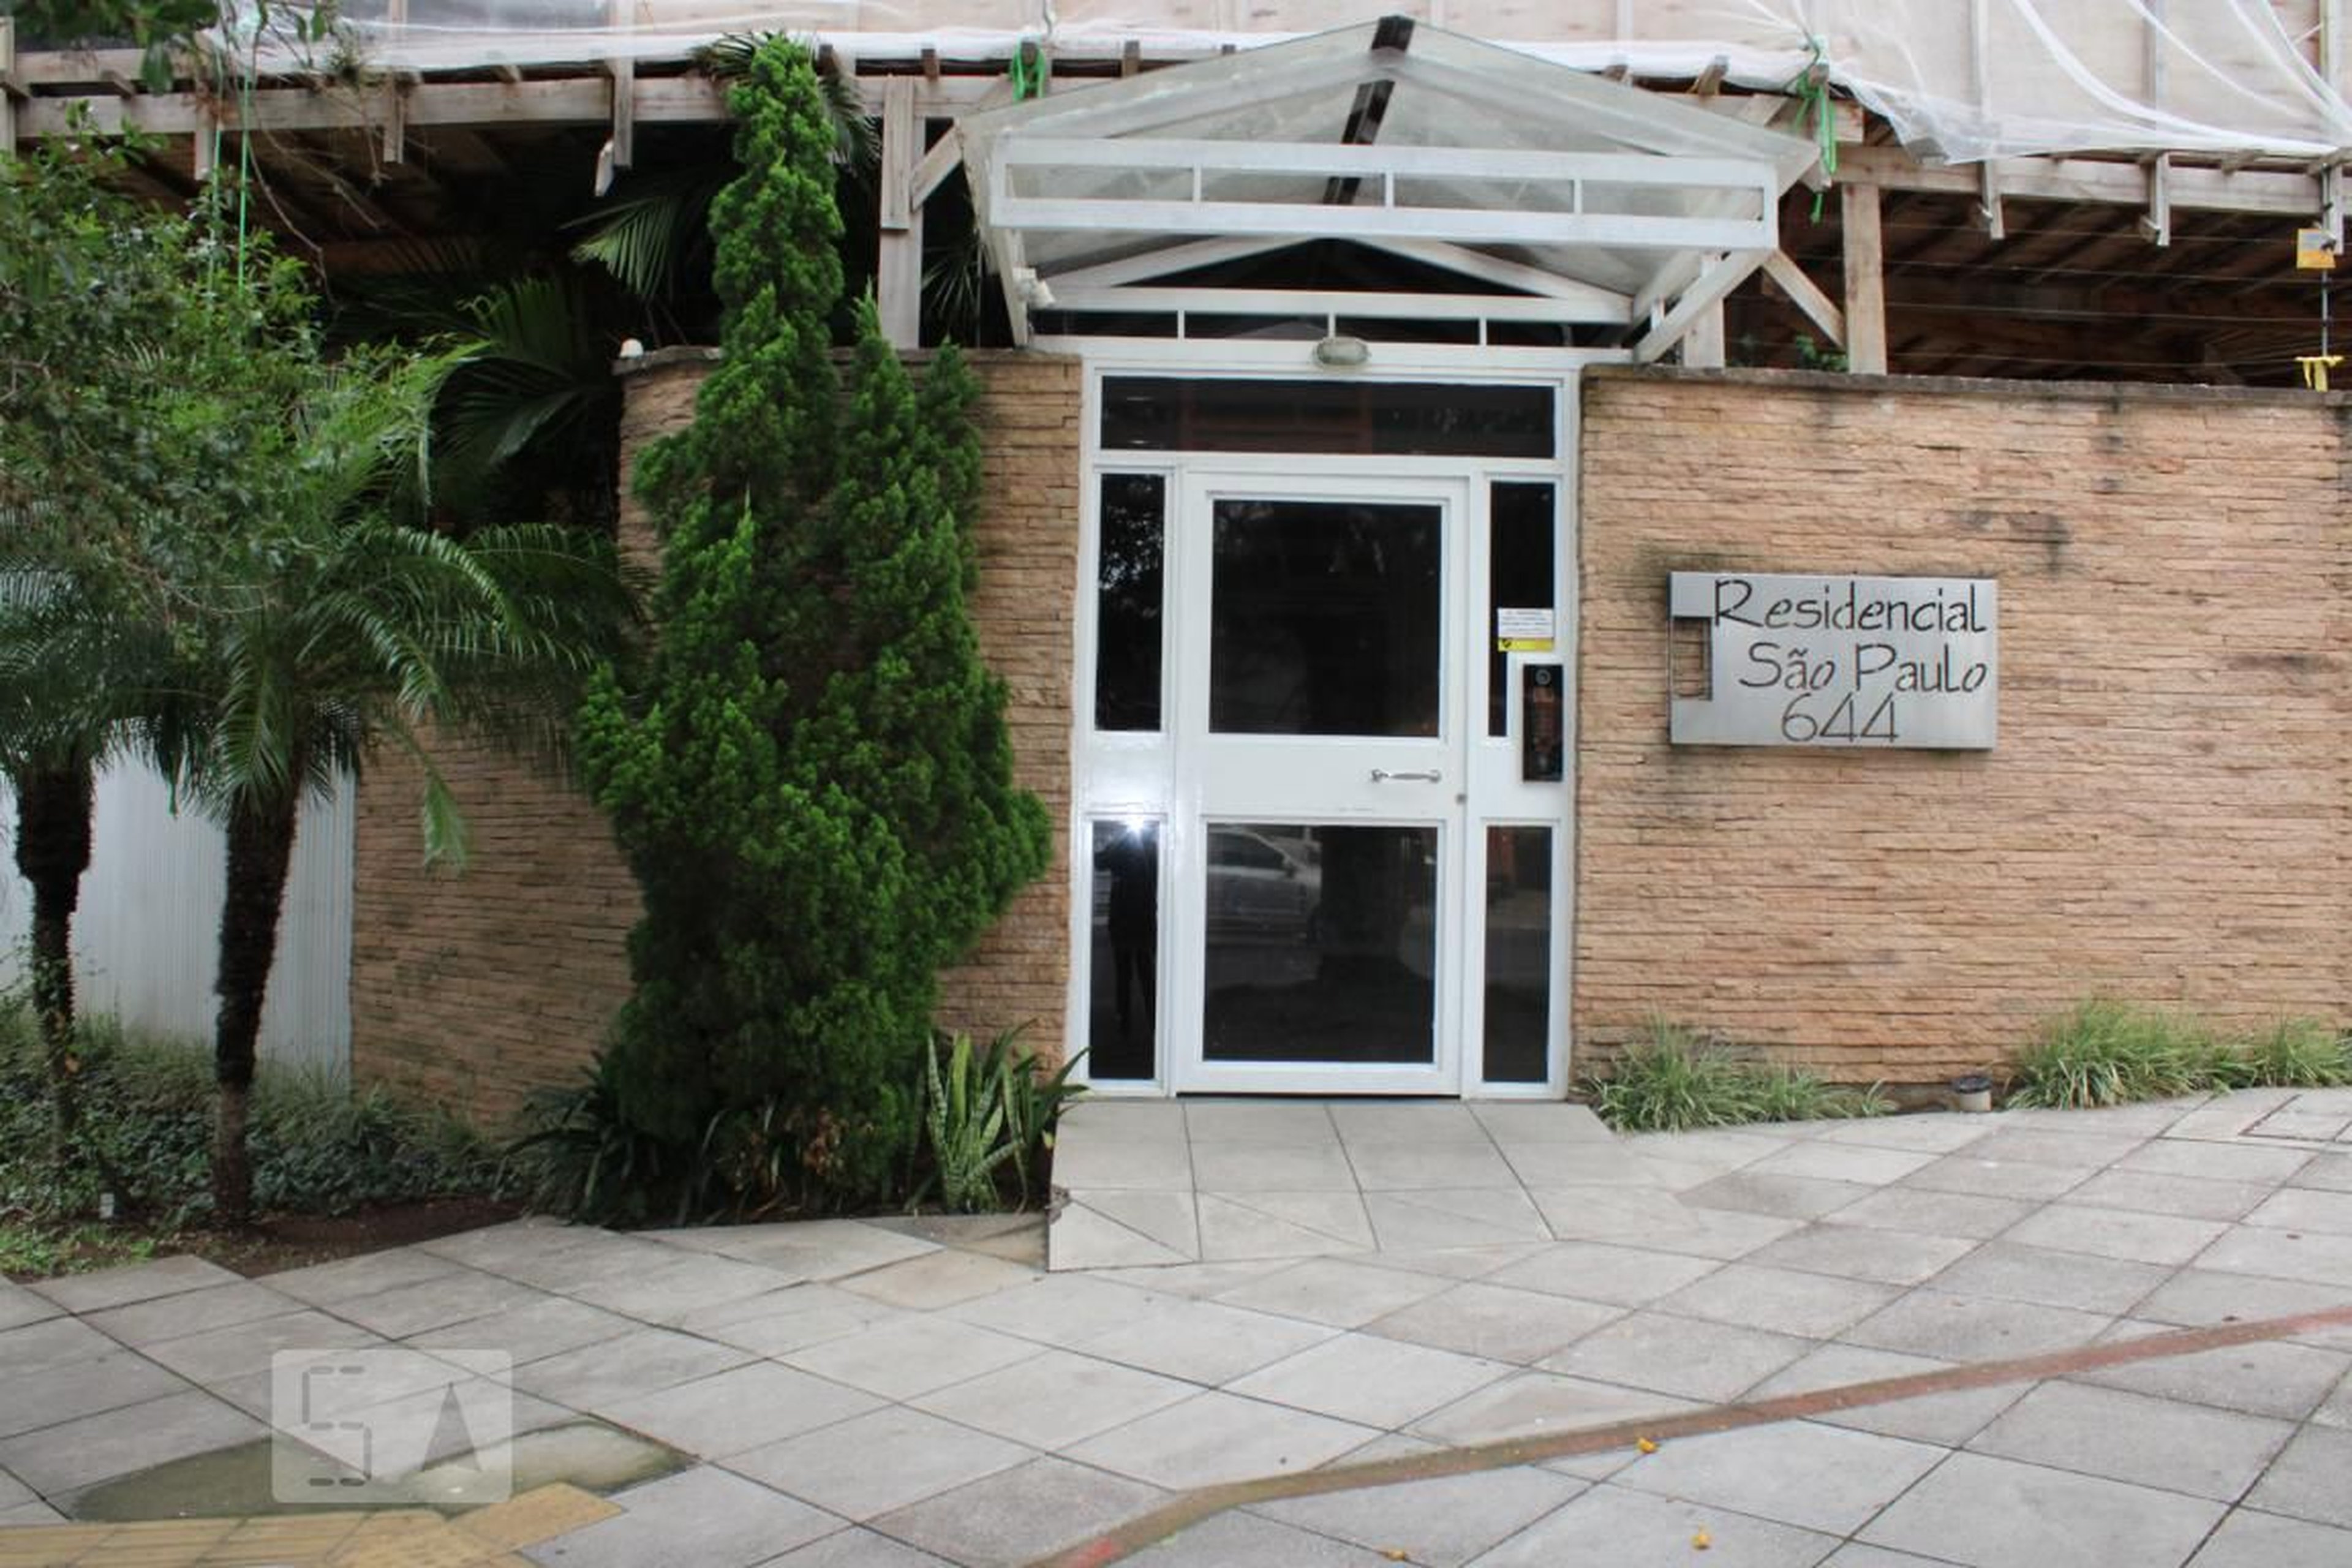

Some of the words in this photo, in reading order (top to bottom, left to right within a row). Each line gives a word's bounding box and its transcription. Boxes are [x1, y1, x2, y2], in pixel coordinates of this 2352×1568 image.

[1715, 579, 1986, 633] Residencial
[1739, 641, 1836, 690] São
[1855, 643, 1986, 693] Paulo
[1781, 692, 1899, 742] 644
